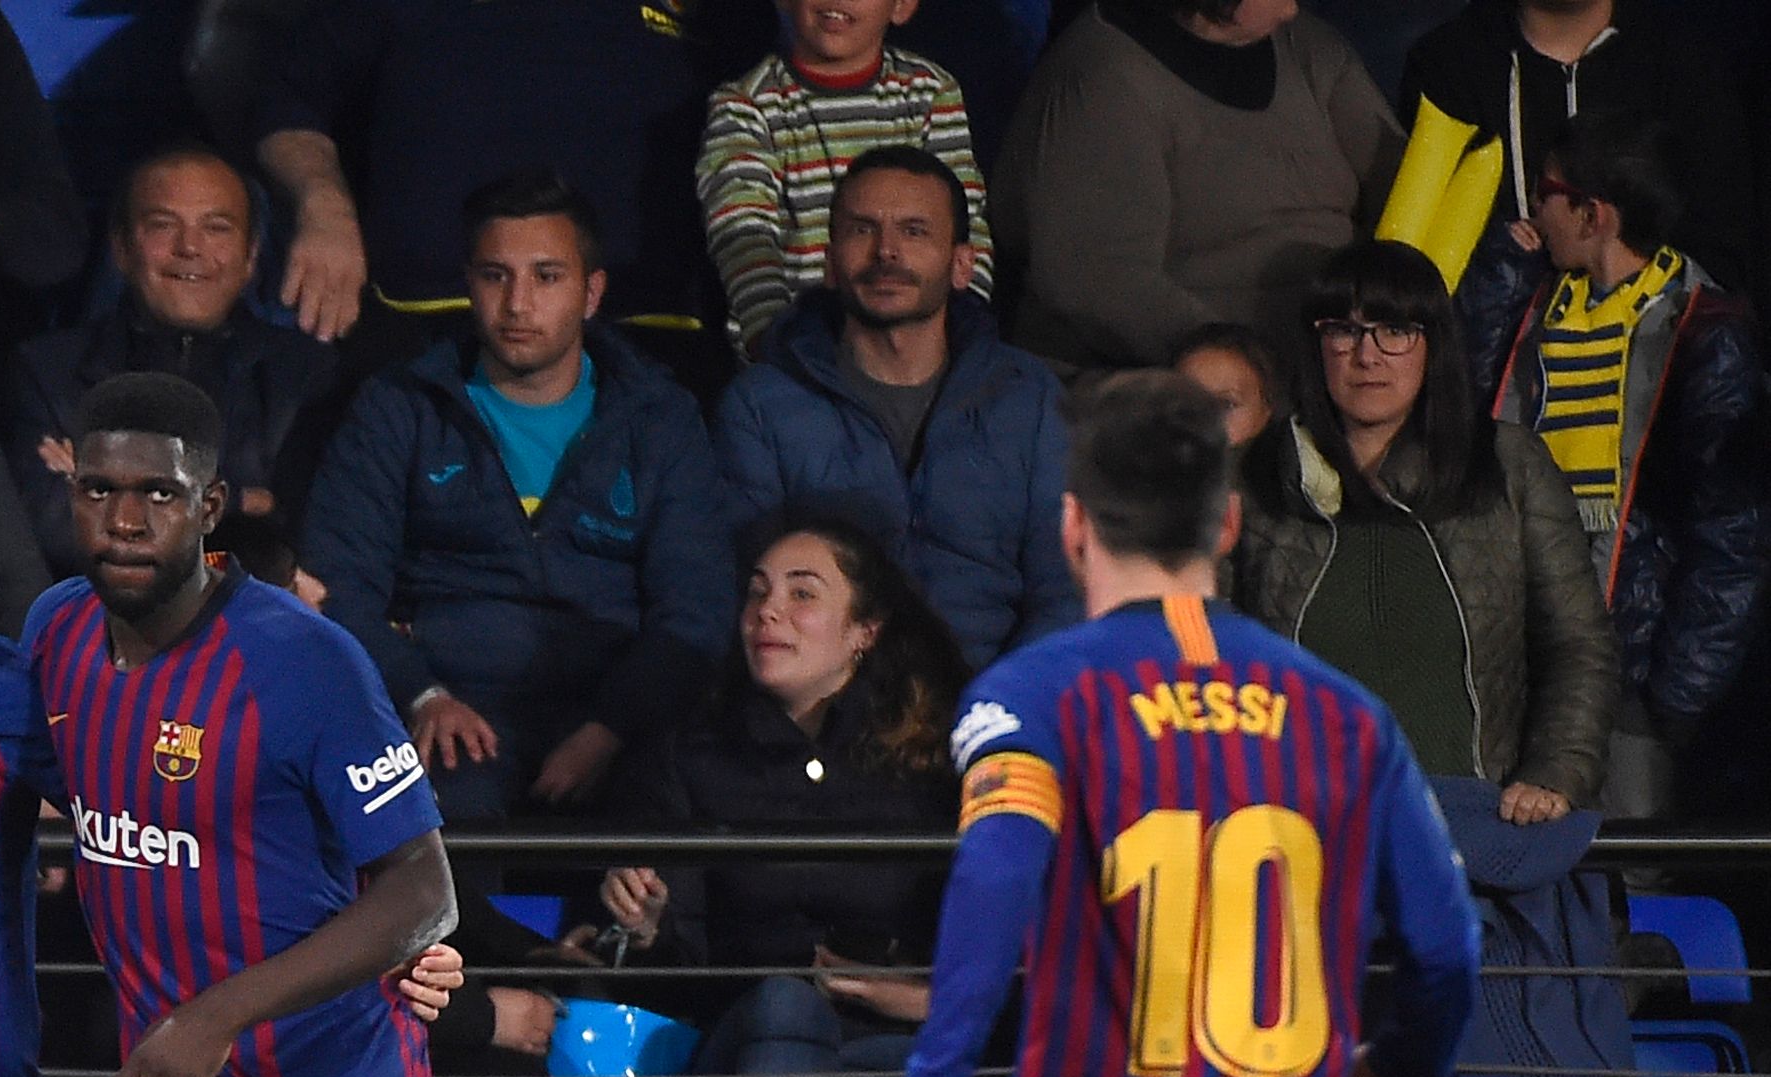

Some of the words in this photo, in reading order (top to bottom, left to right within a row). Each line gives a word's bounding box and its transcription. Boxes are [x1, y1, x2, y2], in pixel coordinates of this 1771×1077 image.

[1130, 681, 1288, 739] MESSI
[346, 740, 420, 793] beko
[71, 794, 200, 869] kuten
